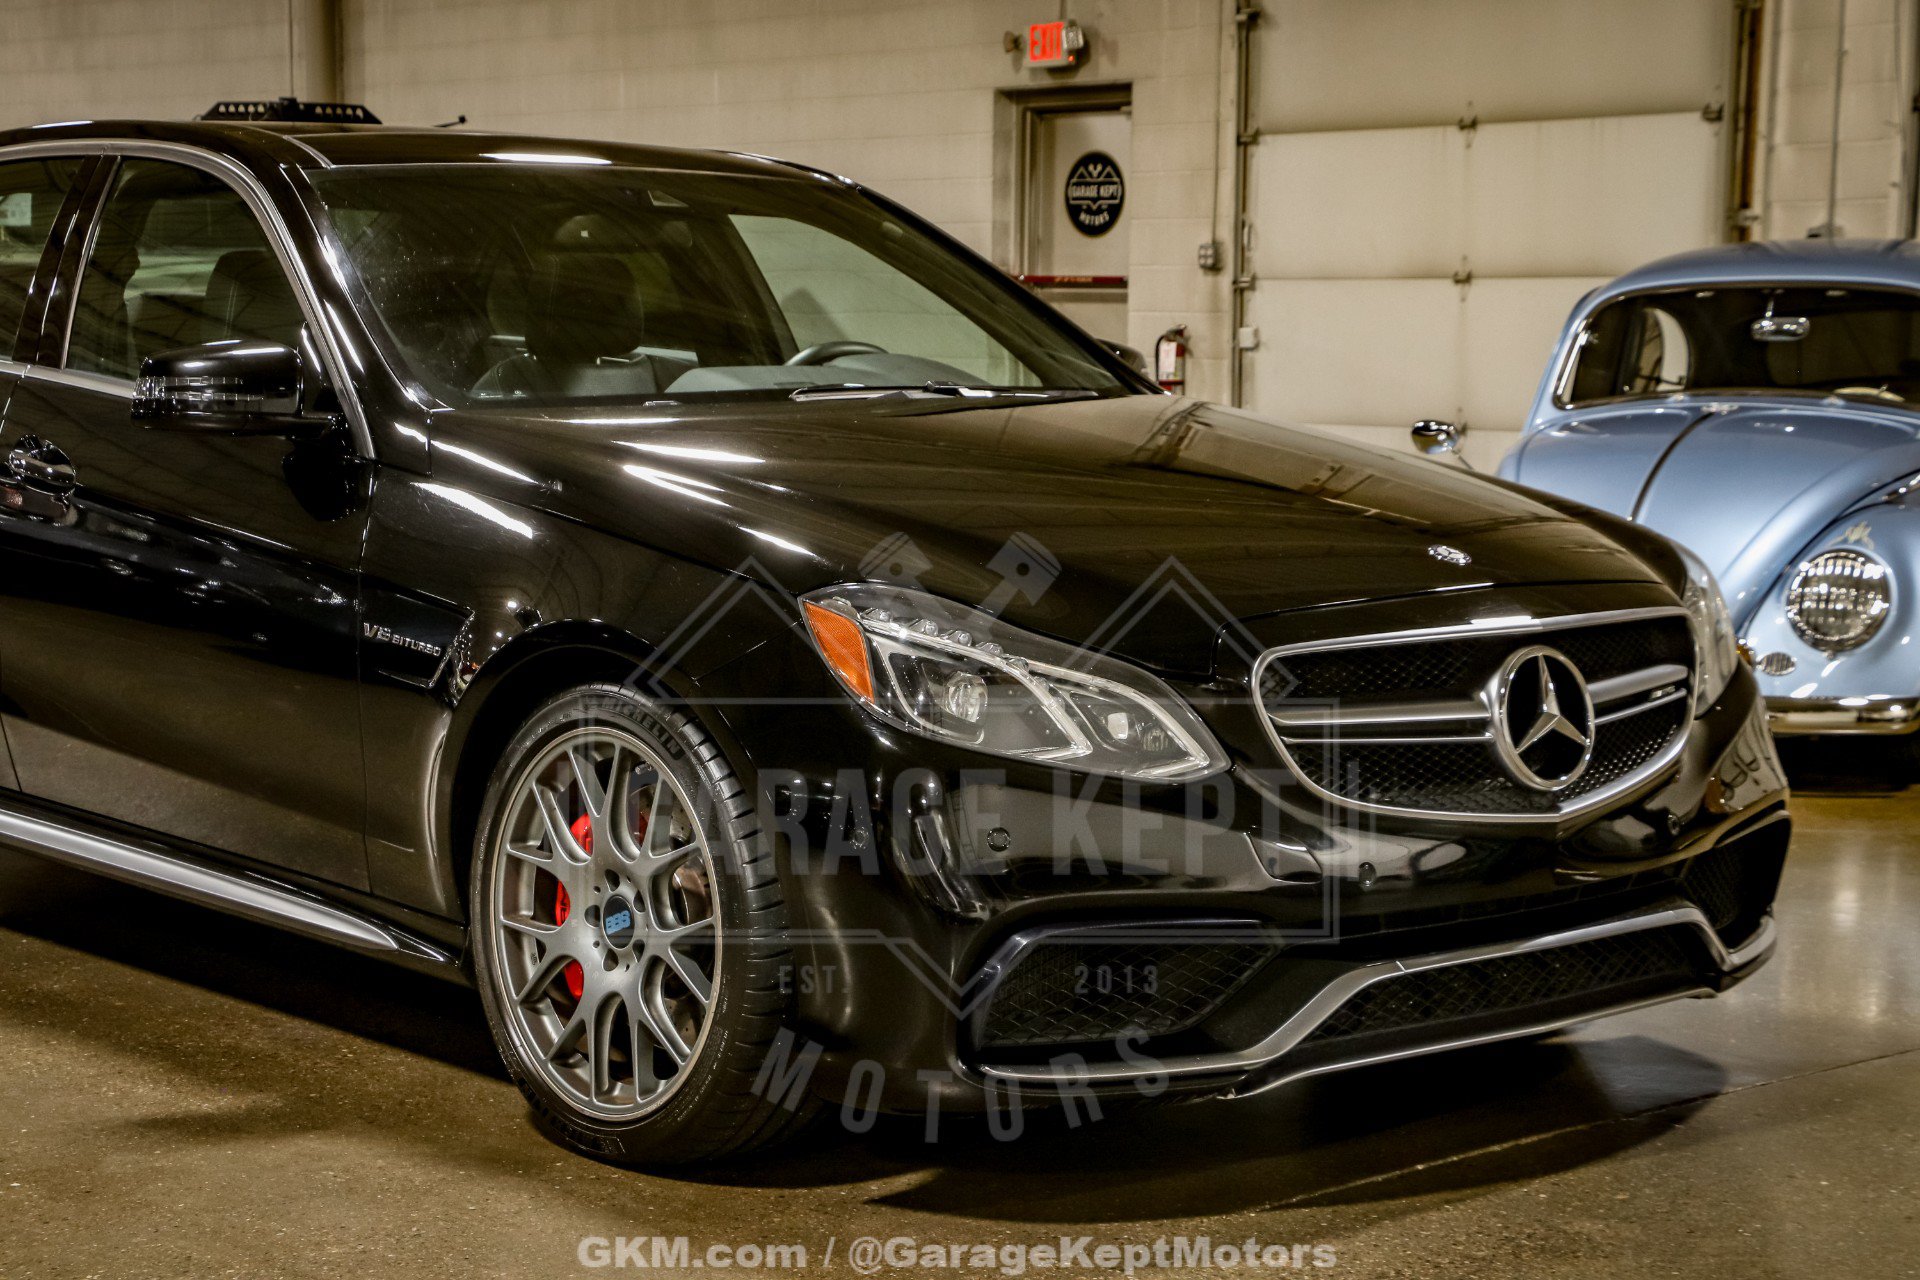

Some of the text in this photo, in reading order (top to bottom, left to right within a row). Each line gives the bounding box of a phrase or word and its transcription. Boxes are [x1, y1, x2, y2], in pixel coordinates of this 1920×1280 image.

[1030, 22, 1064, 61] EXIT
[1072, 185, 1118, 197] GARAGE KEPT
[1079, 211, 1110, 226] MOTORS
[601, 697, 683, 756] MICHELIN
